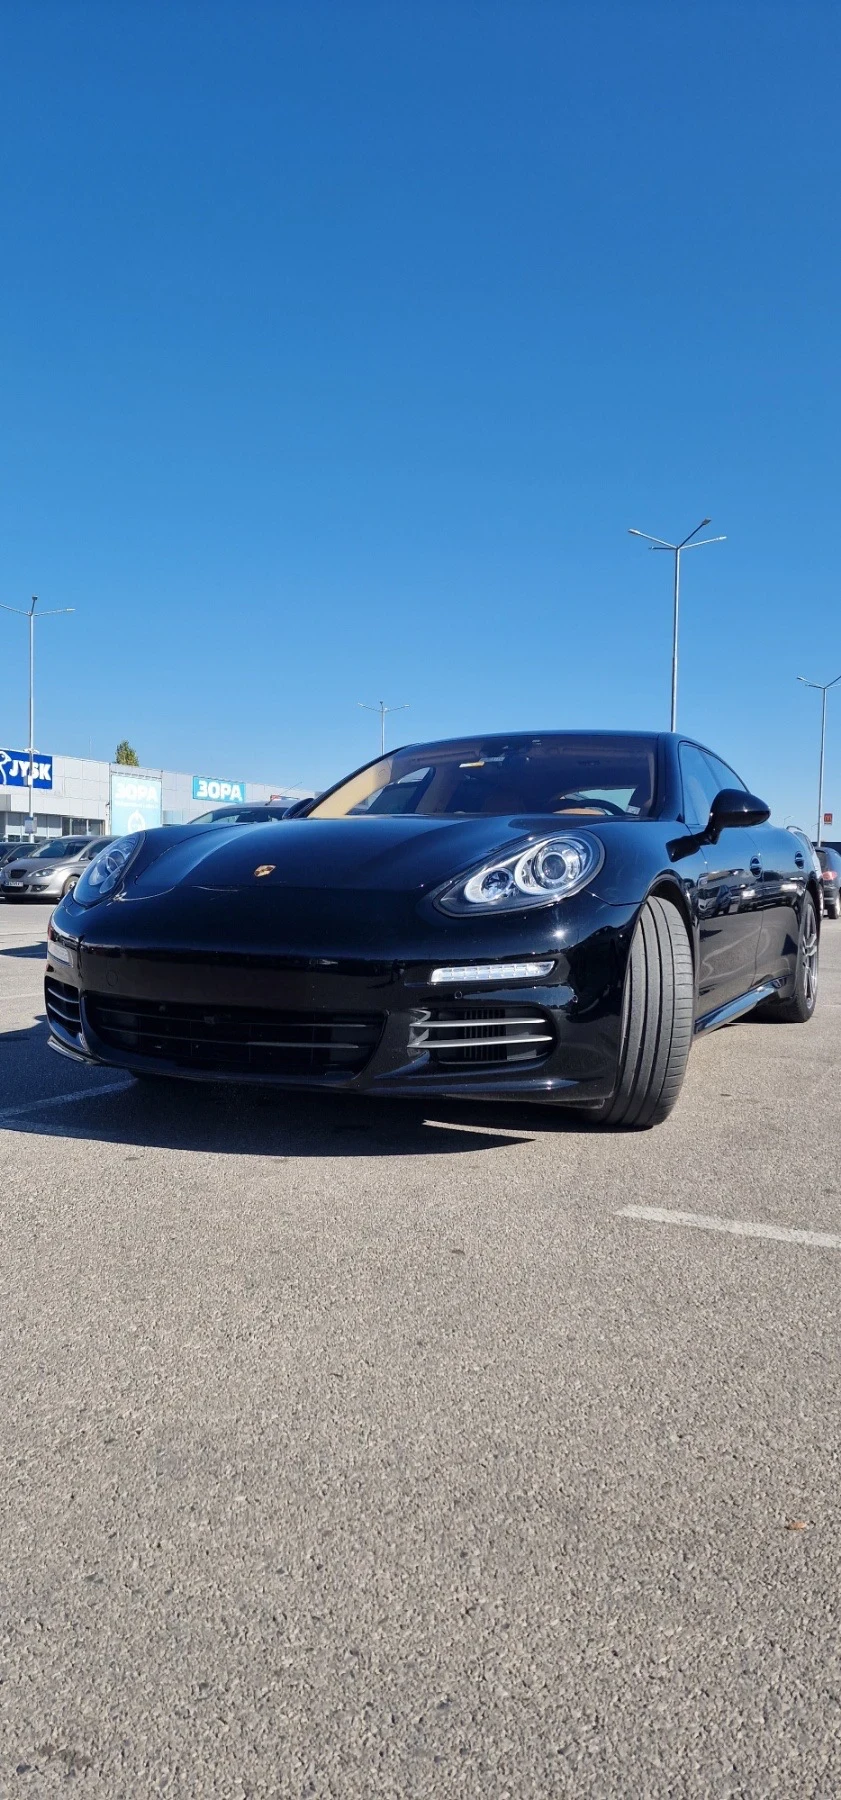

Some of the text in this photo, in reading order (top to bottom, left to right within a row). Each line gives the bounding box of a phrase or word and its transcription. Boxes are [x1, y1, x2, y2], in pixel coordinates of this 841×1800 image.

[9, 759, 51, 781] JYSK
[115, 783, 159, 803] ЗОРА
[197, 780, 243, 801] ЗОРА
